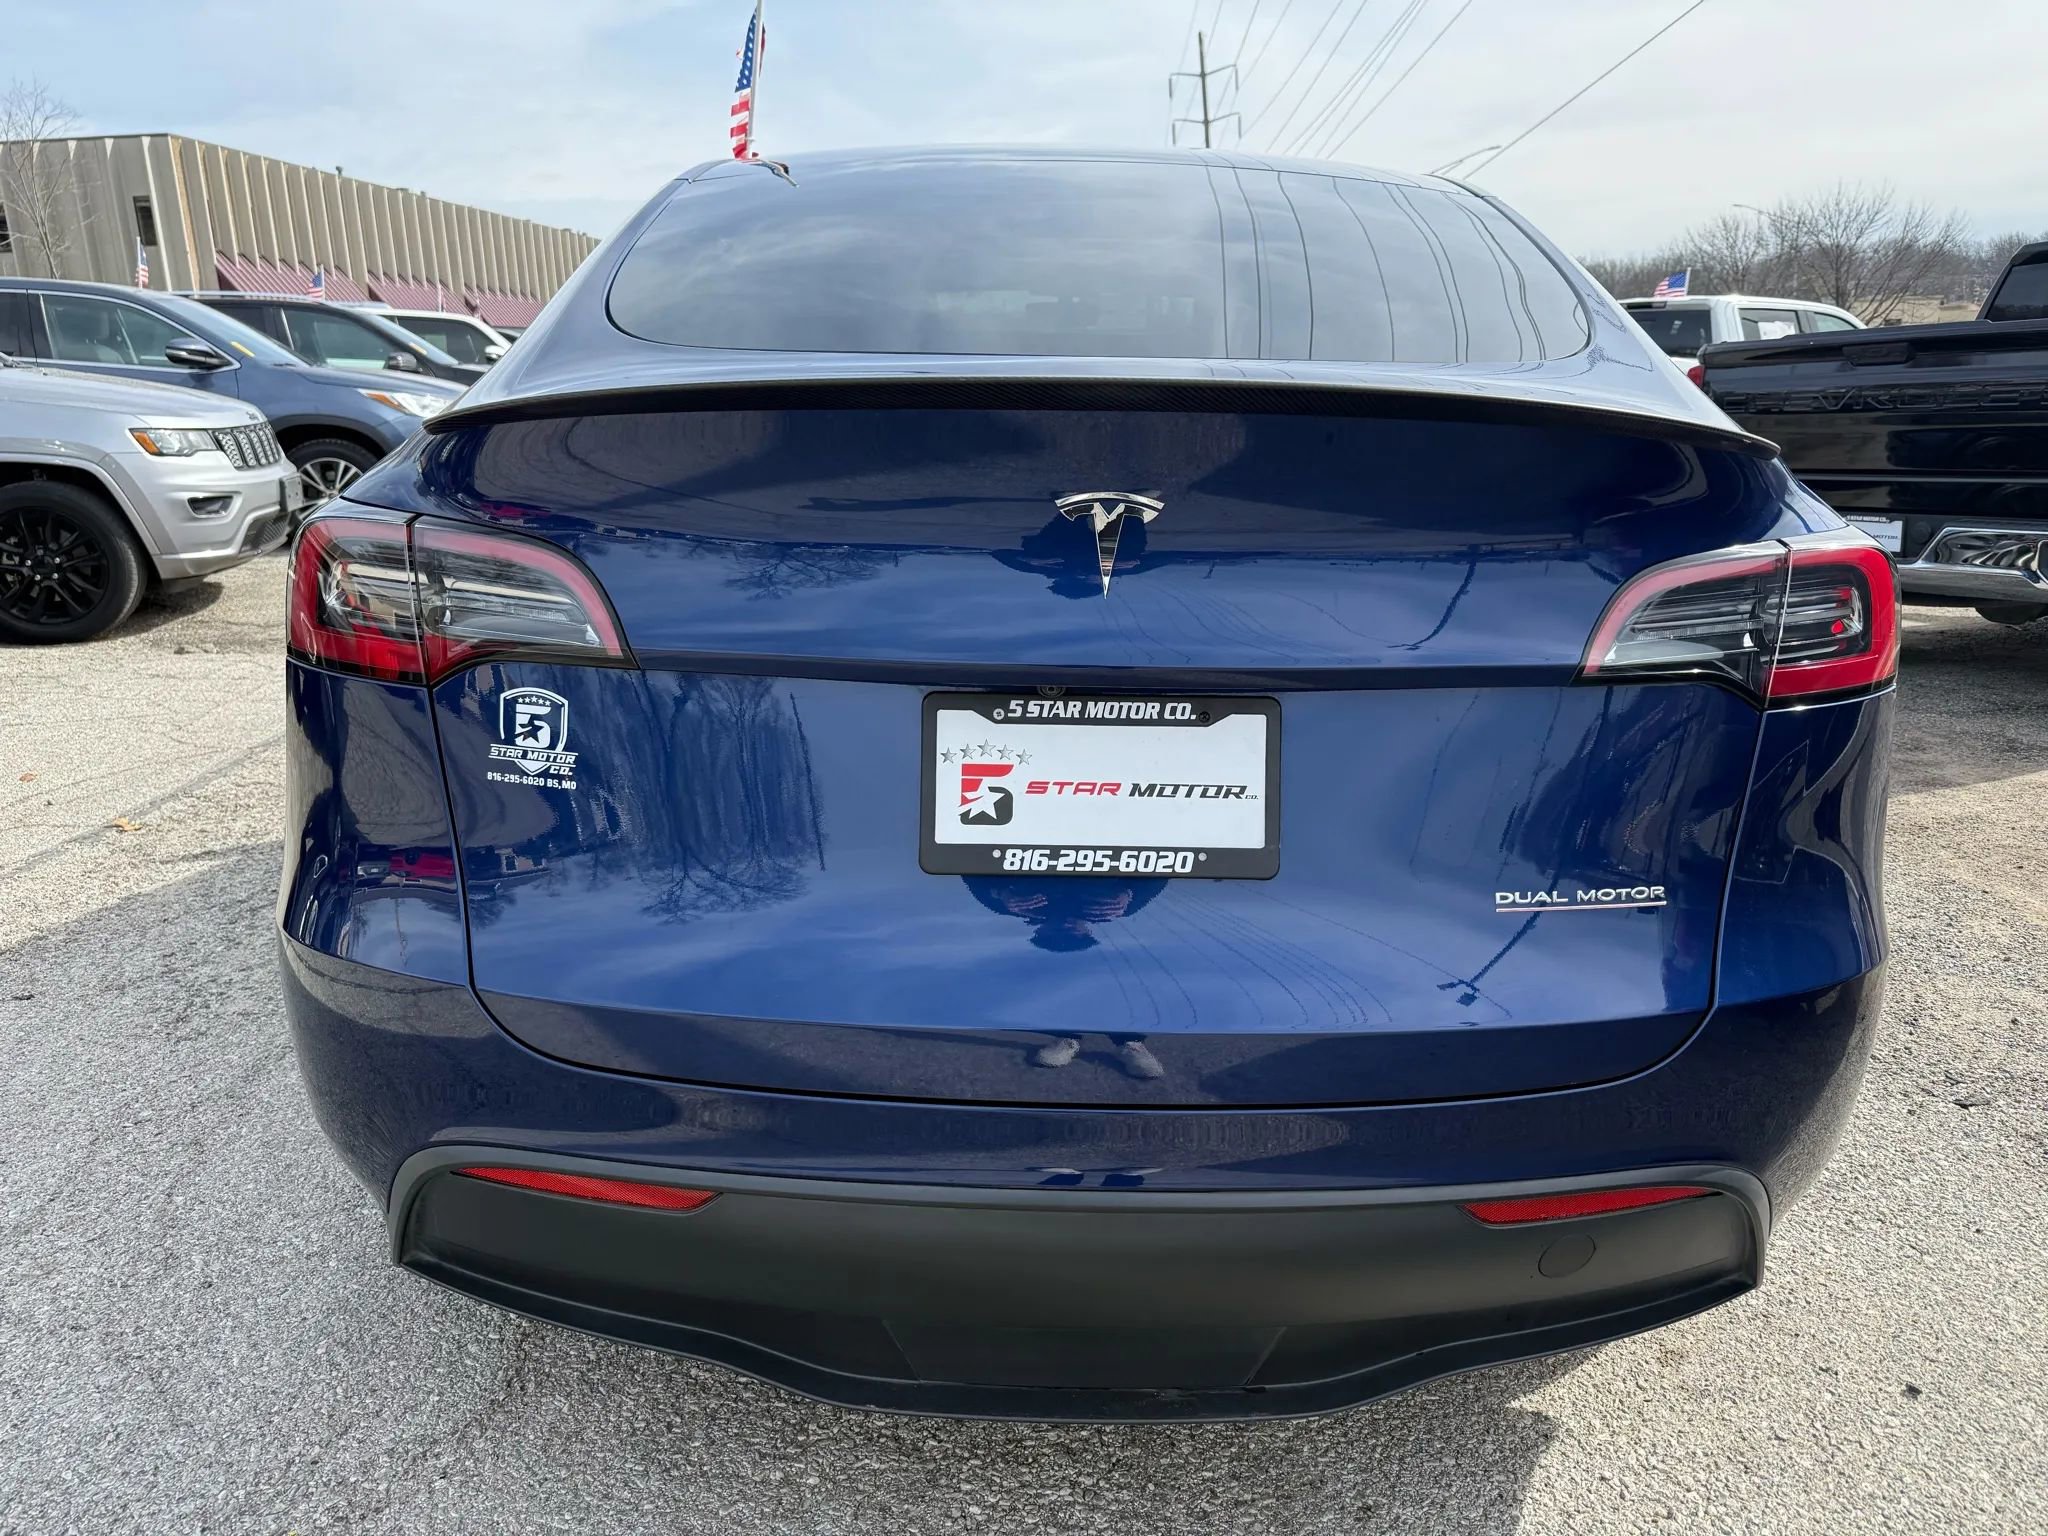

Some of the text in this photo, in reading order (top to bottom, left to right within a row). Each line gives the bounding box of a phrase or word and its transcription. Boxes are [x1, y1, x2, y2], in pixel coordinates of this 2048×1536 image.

[1007, 699, 1197, 720] 5 STAR MOTOR CO.
[490, 746, 576, 764] STAR MOTOR
[487, 771, 545, 787] 816-295-6020
[549, 765, 573, 776] CO.
[1025, 781, 1122, 797] STAR
[1128, 783, 1248, 800] MOTOR
[1002, 848, 1195, 873] 816-295-6020
[1495, 885, 1666, 905] DUAL MOTOR
